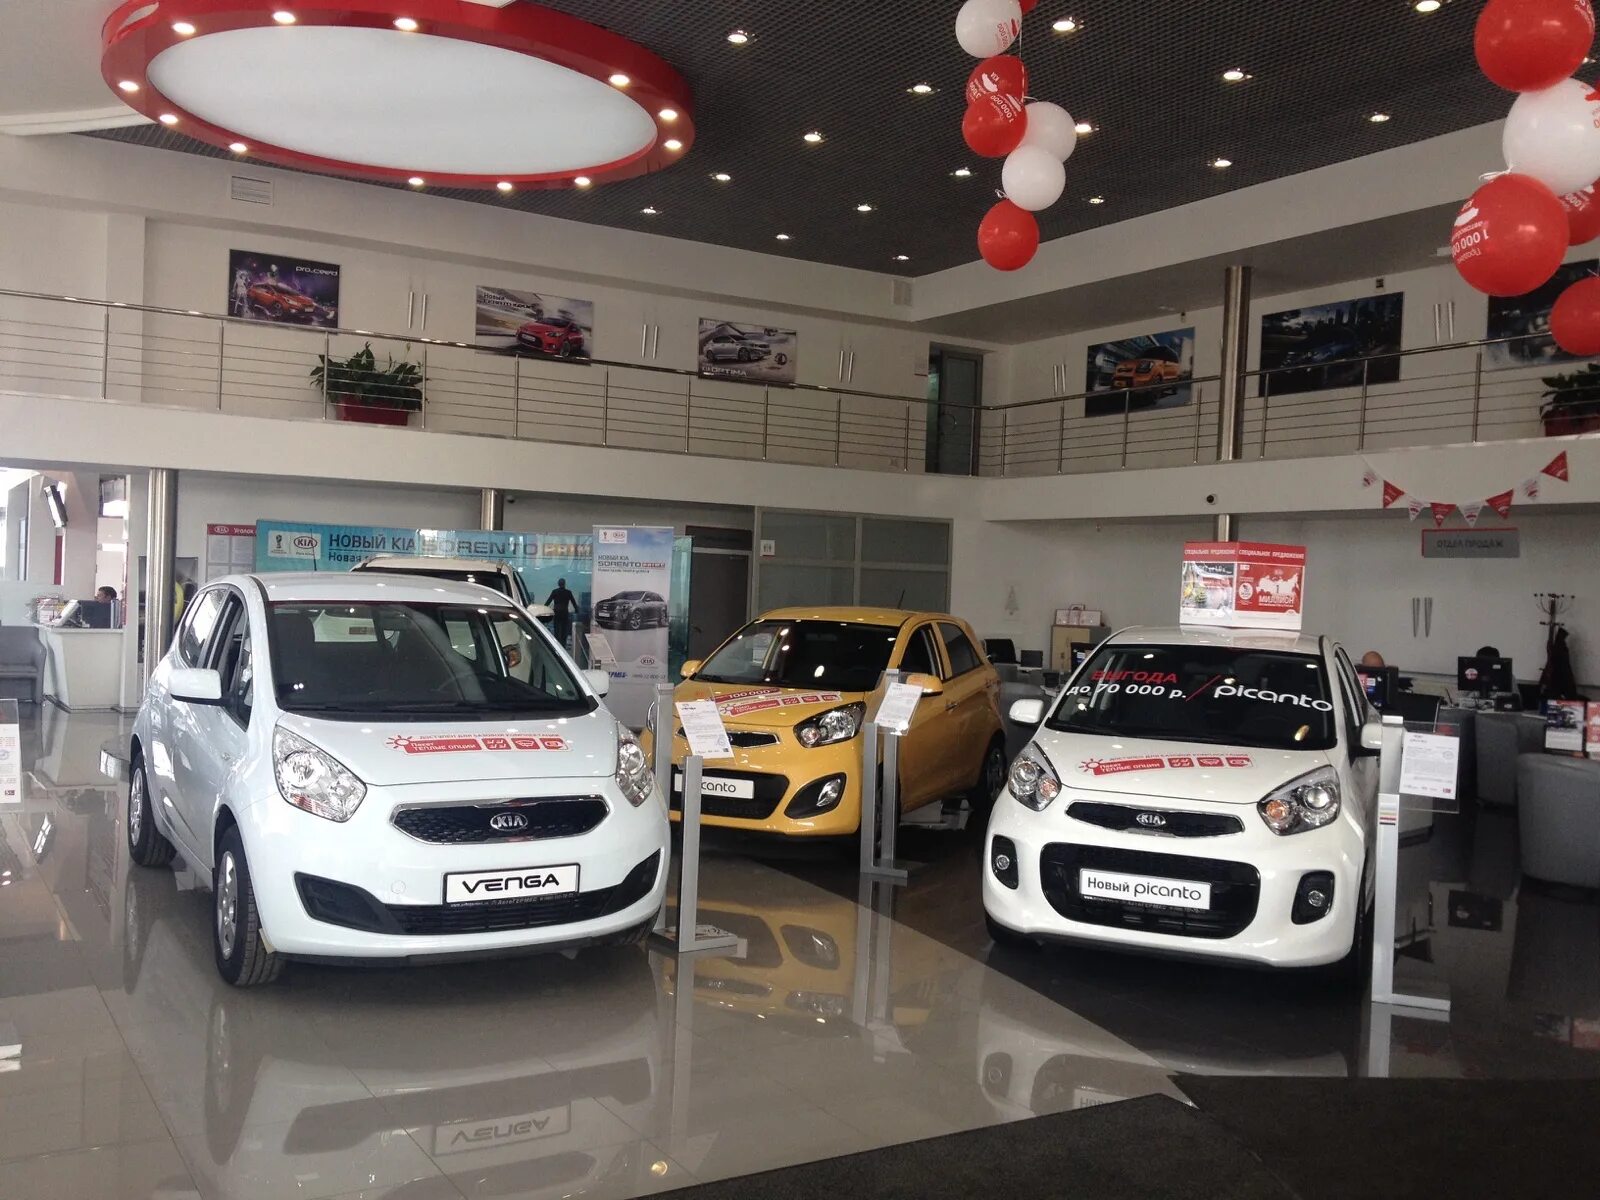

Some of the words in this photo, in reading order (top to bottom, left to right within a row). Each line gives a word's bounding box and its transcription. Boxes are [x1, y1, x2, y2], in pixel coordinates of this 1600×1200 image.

[1482, 229, 1489, 240] 1
[297, 538, 314, 547] KIA
[329, 533, 386, 550] НОВЫЙ
[391, 537, 415, 551] KIA
[421, 538, 538, 556] SORENTO
[328, 552, 362, 562] Новая
[1091, 670, 1178, 684] ВЫГОДА
[1066, 684, 1091, 696] до
[1096, 683, 1121, 693] 70
[1125, 684, 1165, 696] 000
[1169, 687, 1187, 699] р.
[1213, 684, 1333, 712] picanto
[701, 782, 736, 793] canto
[497, 815, 524, 828] KIA
[1141, 814, 1161, 825] KIA
[462, 873, 560, 894] VENGA
[1087, 877, 1130, 893] Новый
[1133, 882, 1202, 901] picanto
